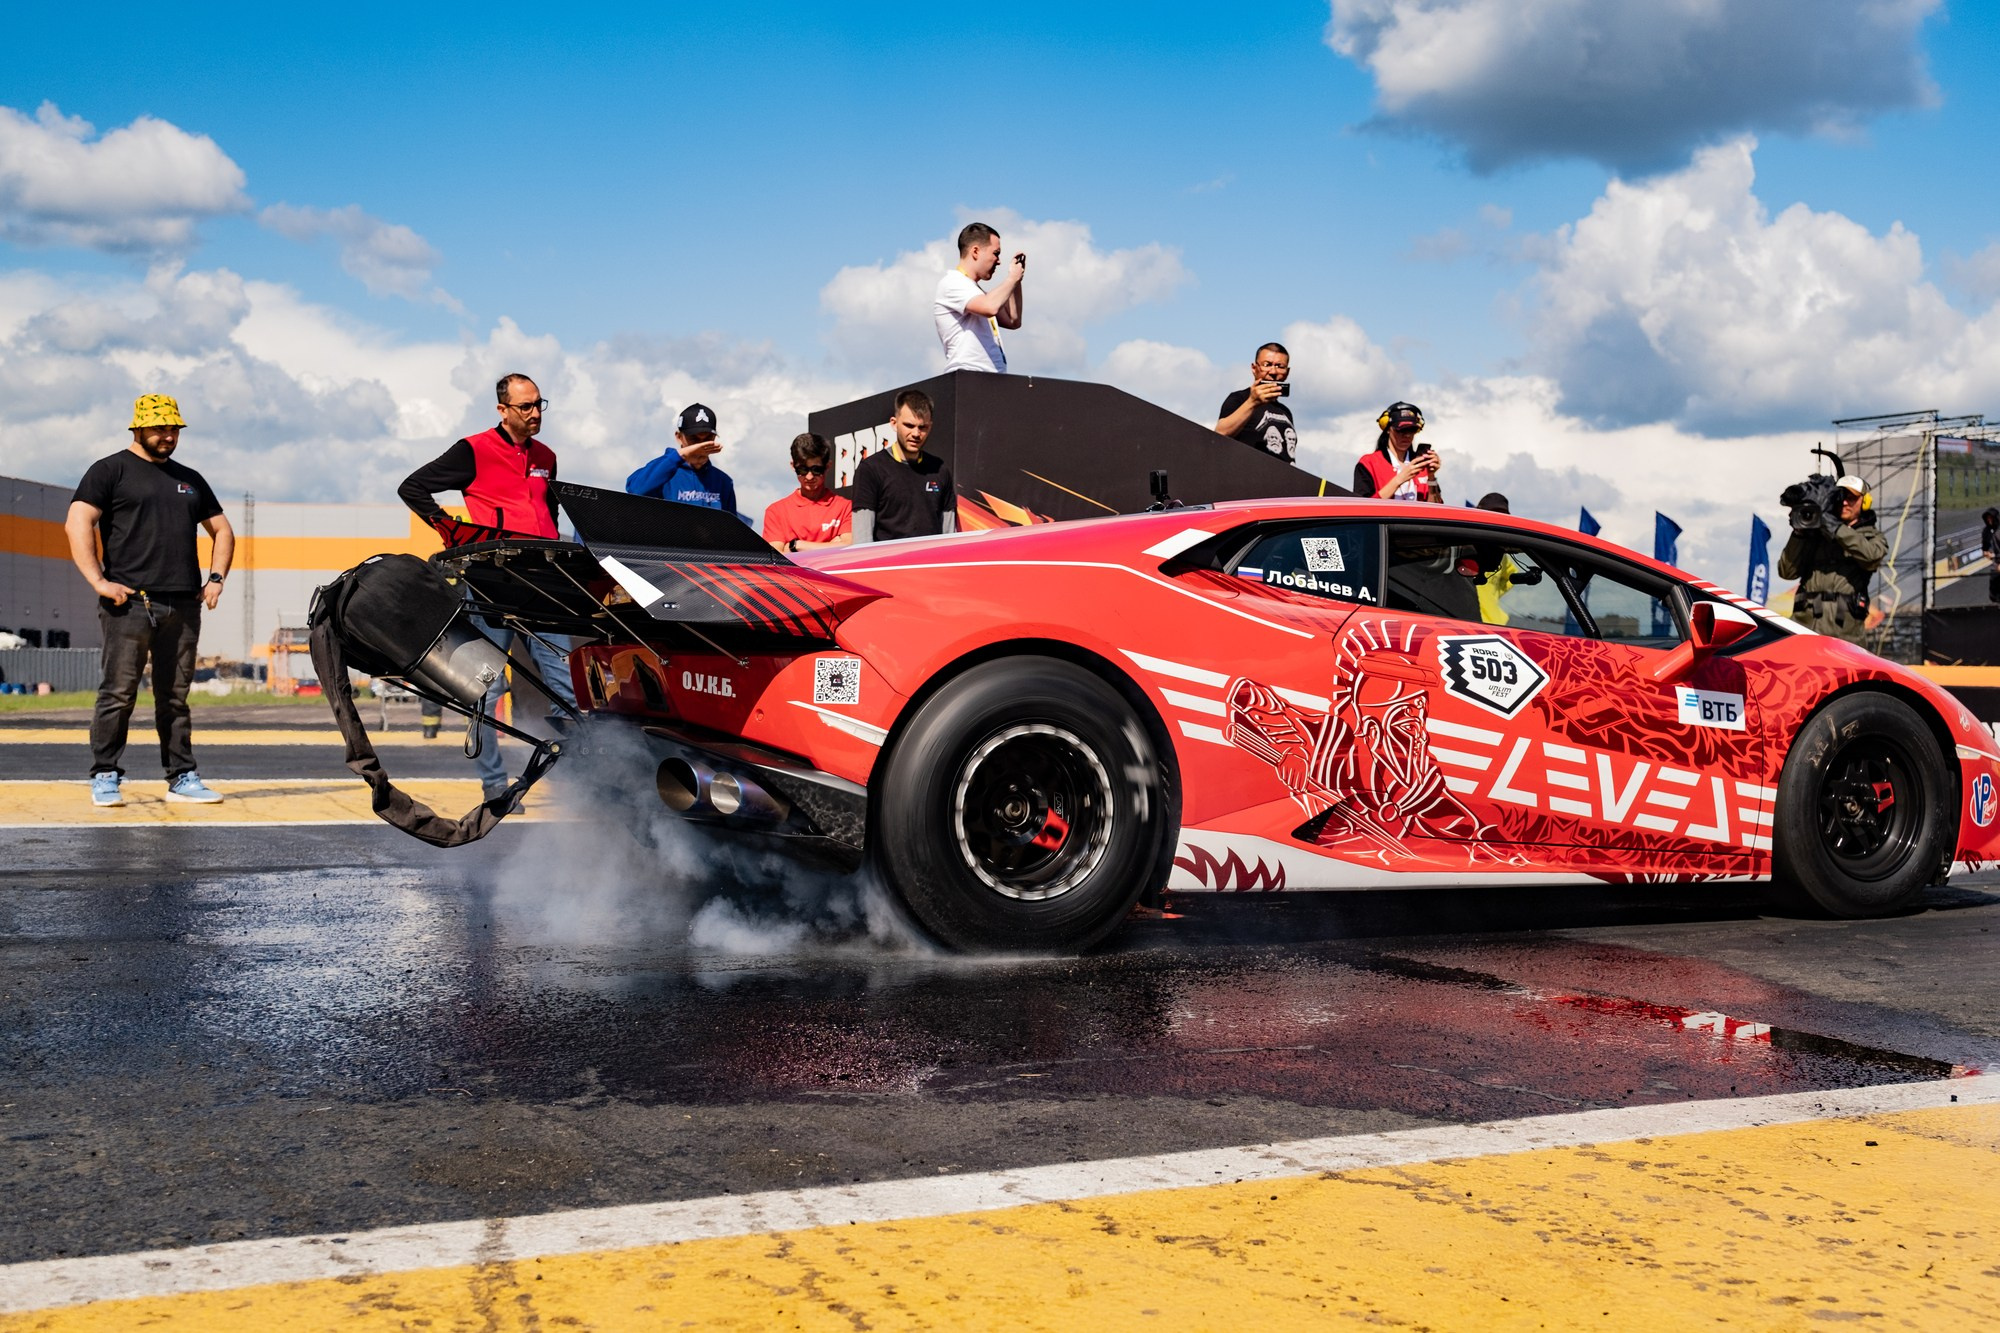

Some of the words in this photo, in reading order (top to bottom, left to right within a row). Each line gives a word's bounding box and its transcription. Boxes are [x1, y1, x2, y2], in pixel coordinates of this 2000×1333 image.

[1266, 570, 1353, 597] Лобачев
[1358, 586, 1377, 602] А.
[682, 671, 737, 698] О.У.К.Б.
[1470, 655, 1518, 685] 503
[1702, 700, 1737, 722] ВТБ
[1972, 773, 1992, 825] VP
